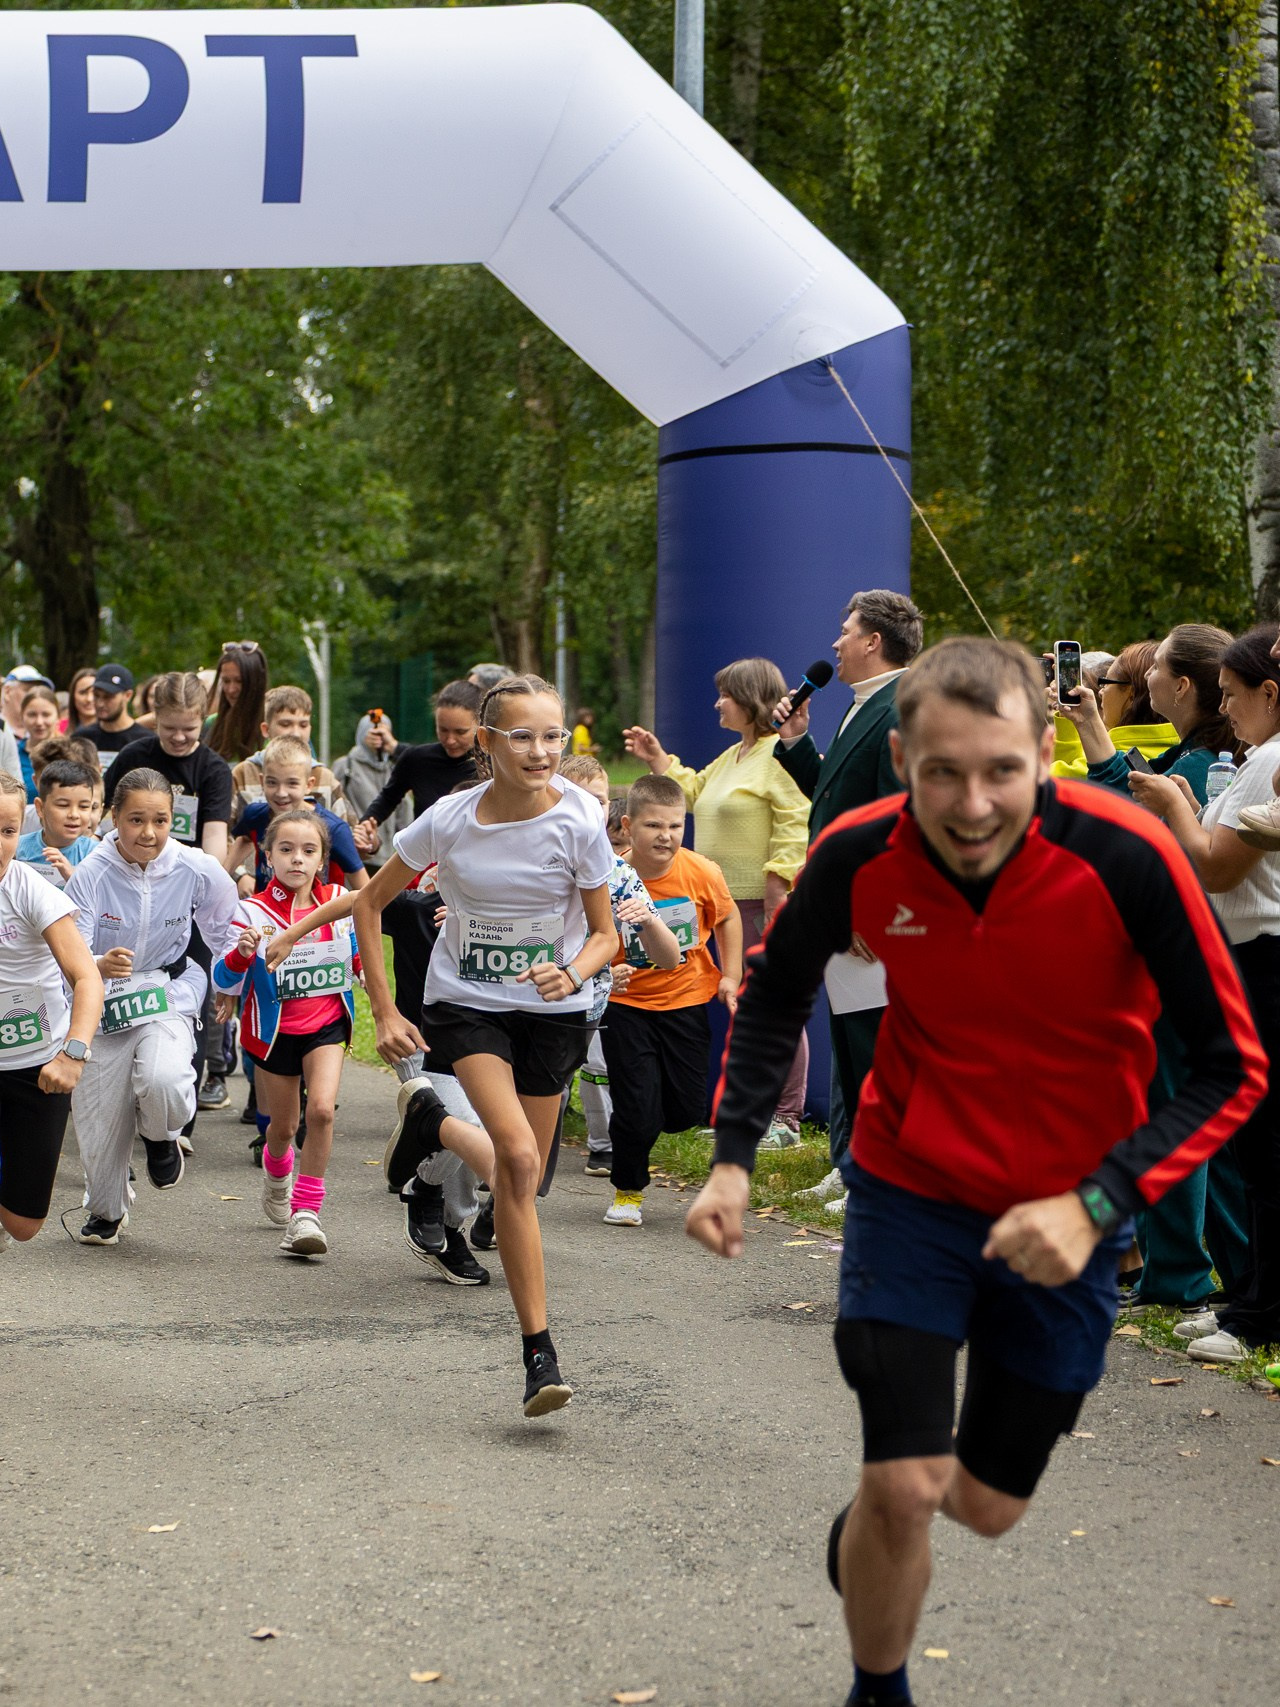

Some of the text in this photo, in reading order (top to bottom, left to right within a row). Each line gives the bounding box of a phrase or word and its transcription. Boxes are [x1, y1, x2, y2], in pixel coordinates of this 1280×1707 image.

[469, 932, 502, 941] КАЗАНЬ
[477, 924, 514, 933] городов
[471, 948, 549, 973] 1084
[285, 967, 343, 991] 1008
[110, 992, 160, 1020] 1114
